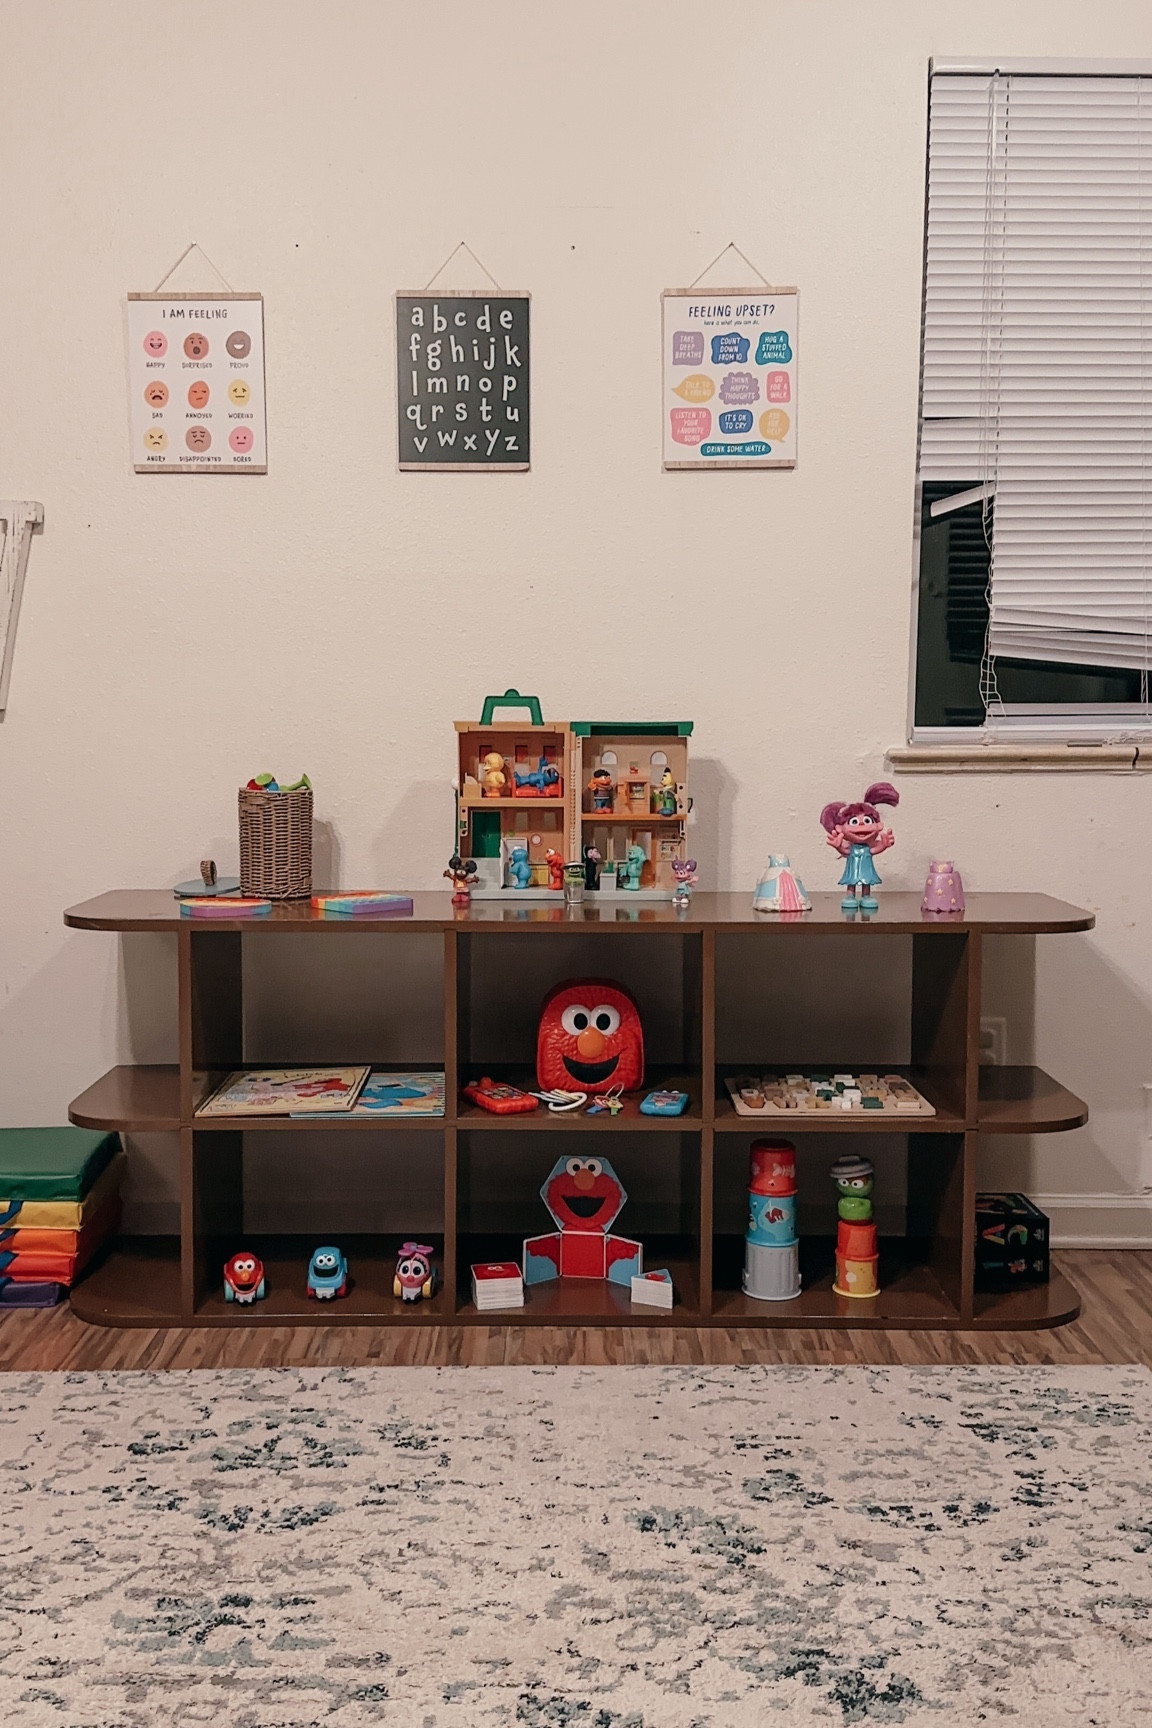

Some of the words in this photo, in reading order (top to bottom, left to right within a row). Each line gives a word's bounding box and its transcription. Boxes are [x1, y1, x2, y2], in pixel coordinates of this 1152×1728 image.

[162, 310, 165, 318] I
[170, 309, 185, 318] AM
[189, 309, 228, 319] FEELING
[411, 307, 424, 327] a
[433, 305, 447, 333] b
[454, 312, 466, 326] c
[477, 305, 490, 332] d
[499, 310, 512, 329] e
[689, 306, 731, 318] FEELING
[736, 304, 775, 317] UPSET?
[409, 333, 420, 361] f
[427, 340, 441, 371] g
[449, 335, 464, 362] h
[472, 339, 479, 361] i
[483, 337, 495, 370] j
[505, 335, 522, 367] k
[718, 353, 736, 361] FROM
[427, 377, 447, 393] m
[457, 375, 469, 391] n
[478, 378, 492, 392] o
[503, 375, 516, 401] p
[407, 404, 427, 430] q
[431, 405, 443, 421] r
[456, 403, 467, 421] s
[480, 398, 492, 421] t
[506, 406, 519, 422] u
[414, 436, 428, 453] v
[437, 430, 457, 446] w
[464, 434, 477, 450] x
[485, 429, 500, 456] y
[504, 436, 519, 451] z
[727, 445, 742, 453] SOME
